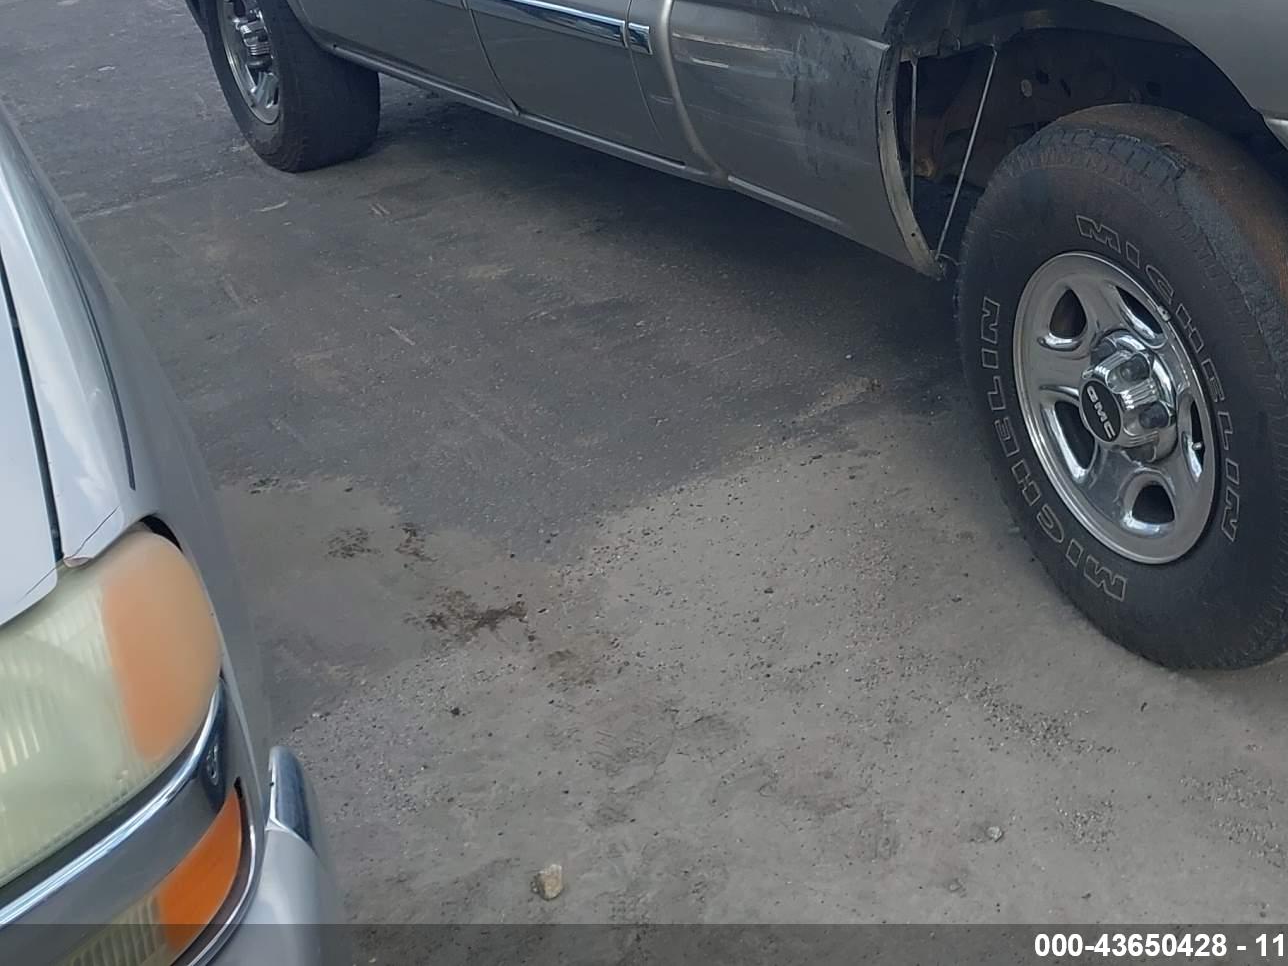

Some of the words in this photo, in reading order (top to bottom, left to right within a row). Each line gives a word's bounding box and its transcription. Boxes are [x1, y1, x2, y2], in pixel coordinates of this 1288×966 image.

[981, 296, 1127, 602] MICHELIN
[1076, 214, 1242, 542] MICHELIN
[1086, 385, 1117, 439] GMC
